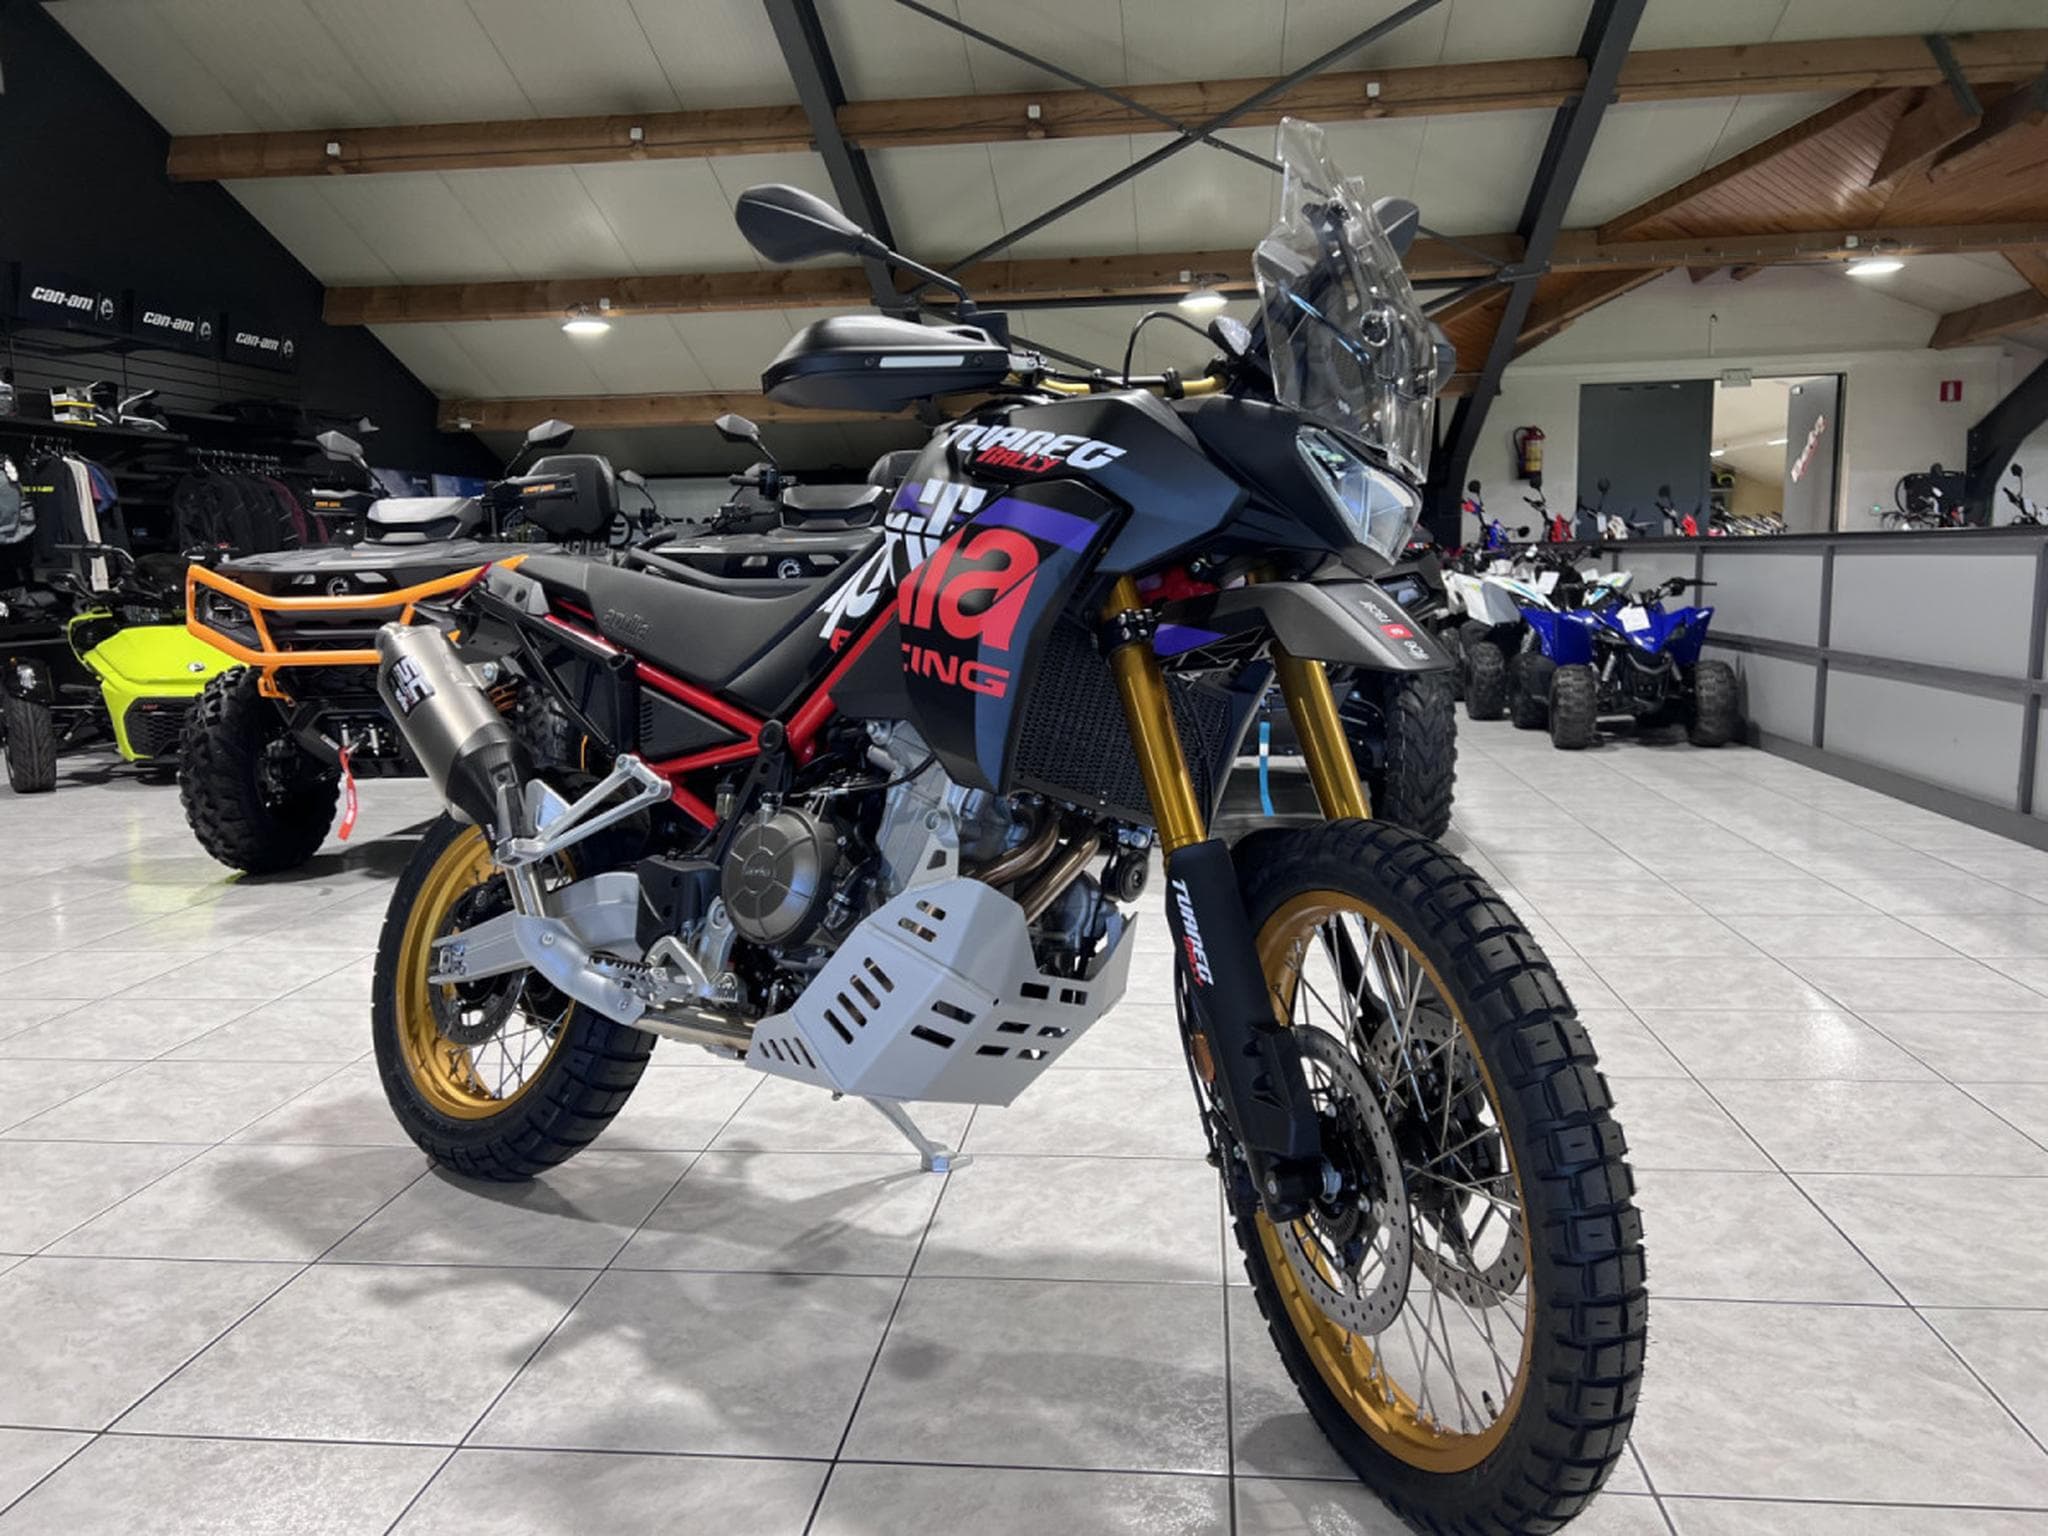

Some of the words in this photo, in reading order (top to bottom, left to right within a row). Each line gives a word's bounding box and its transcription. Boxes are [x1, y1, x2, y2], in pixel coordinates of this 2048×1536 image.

[31, 286, 94, 311] can-am
[143, 311, 195, 333] can-am
[235, 332, 280, 351] can-am
[940, 423, 1127, 469] TUAREG
[976, 446, 1061, 473] RALLY
[1172, 879, 1214, 986] TUAREG
